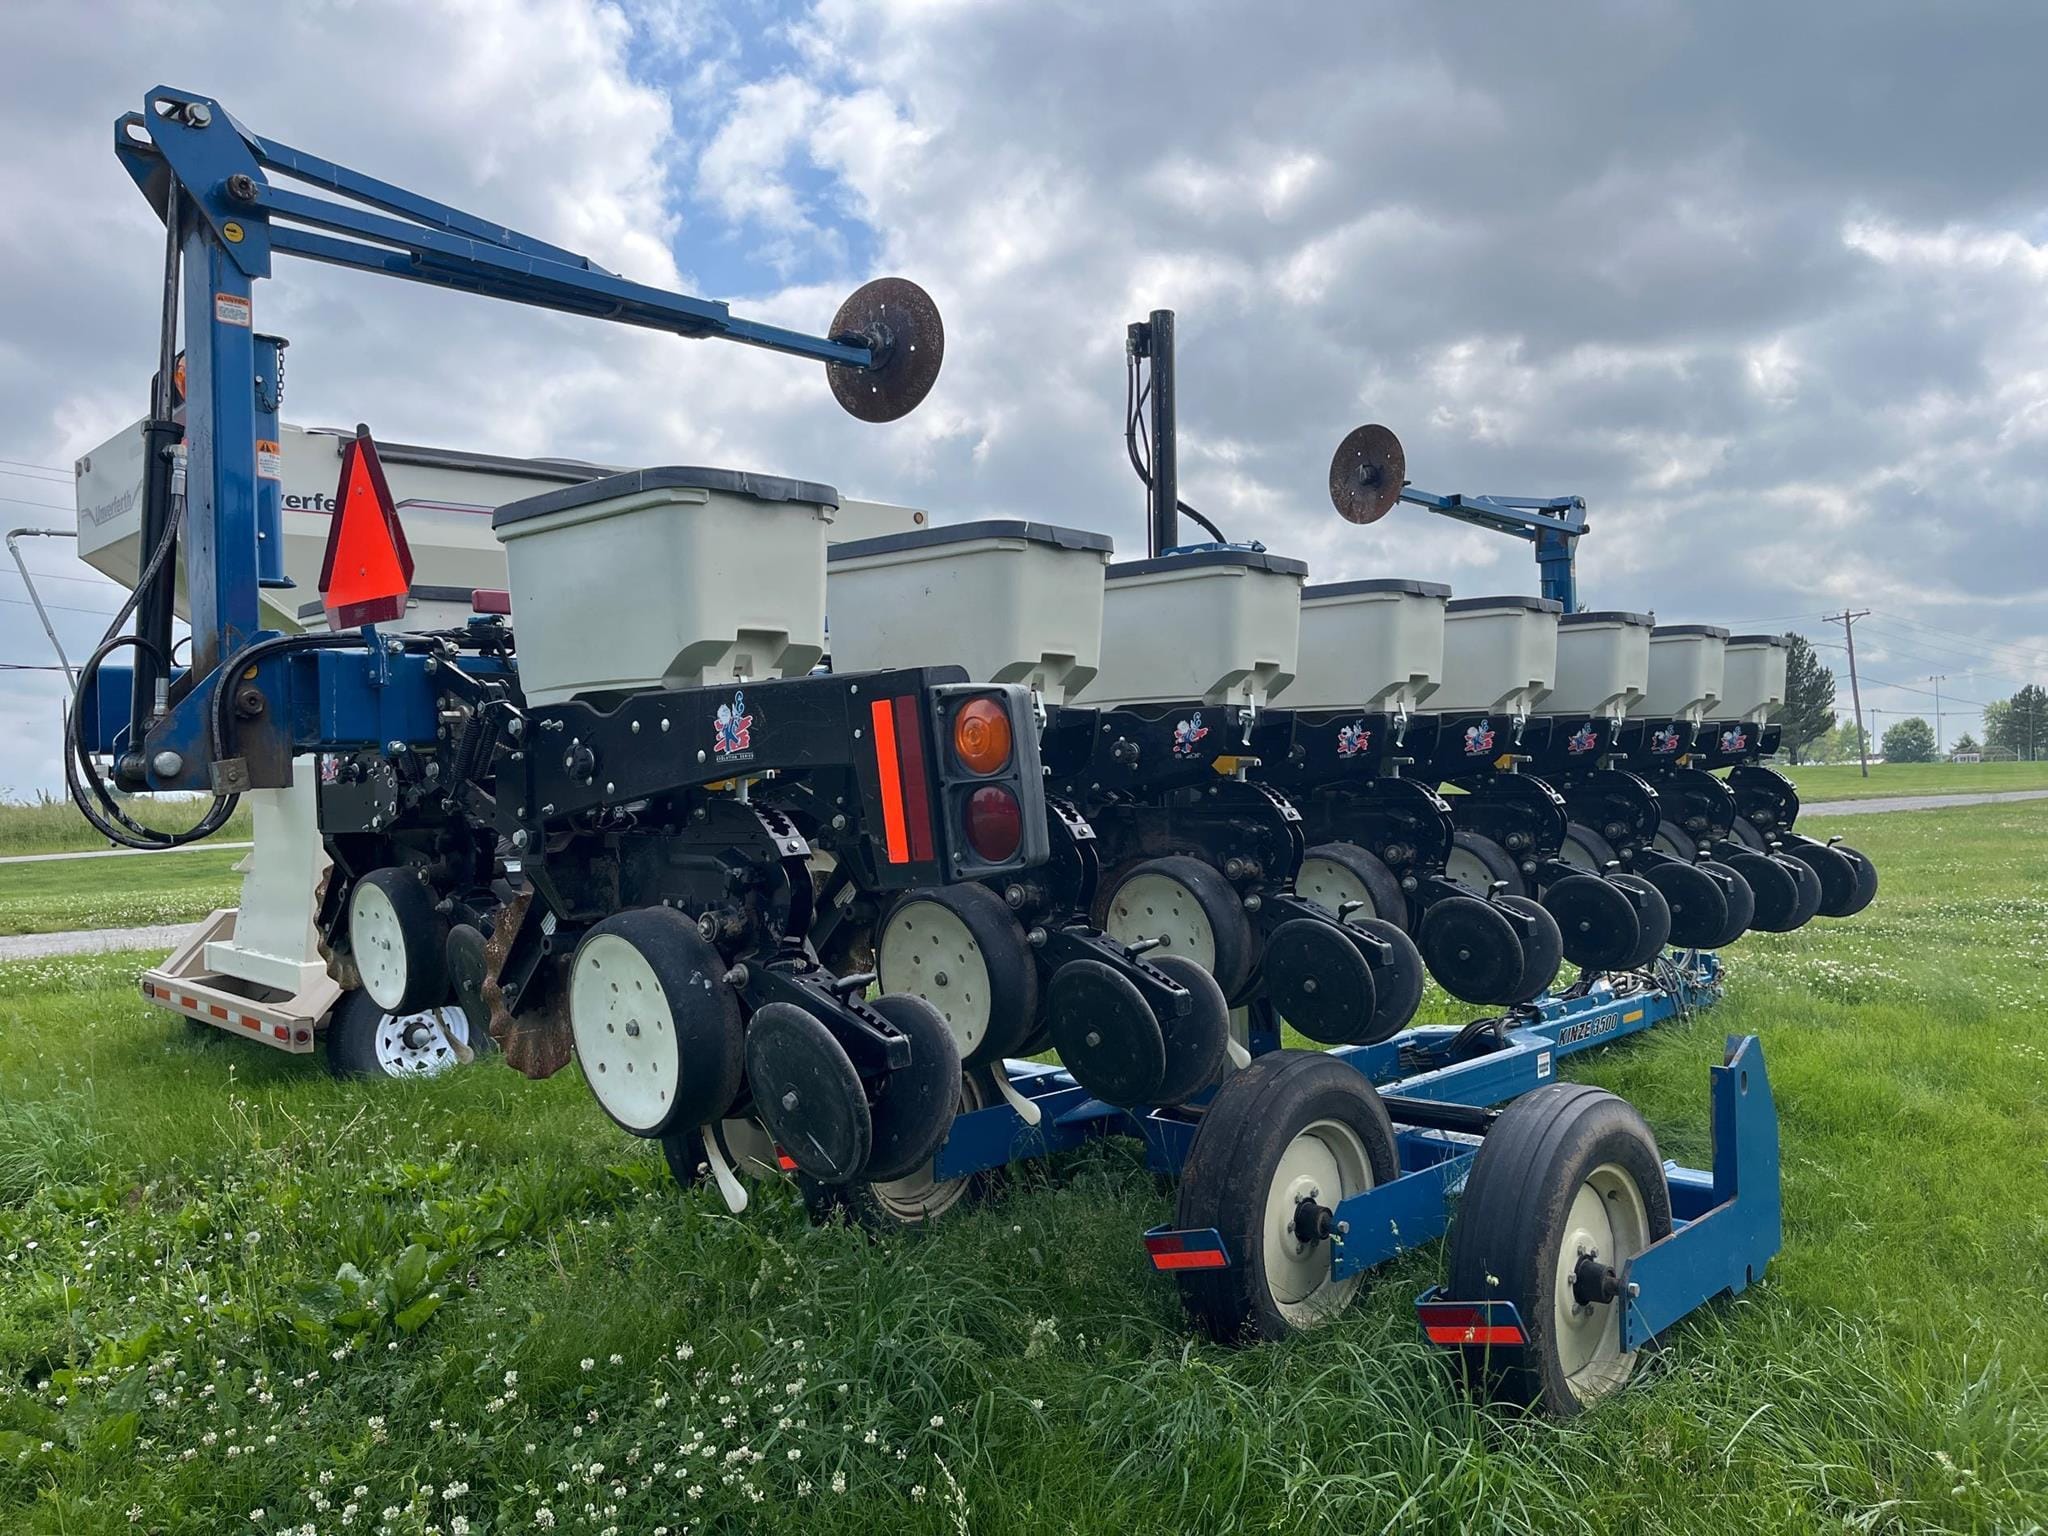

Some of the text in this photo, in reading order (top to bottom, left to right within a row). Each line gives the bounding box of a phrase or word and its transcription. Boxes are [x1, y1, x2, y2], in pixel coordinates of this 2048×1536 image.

[281, 493, 336, 512] erfe
[1559, 1012, 1618, 1047] KINZE 3500
